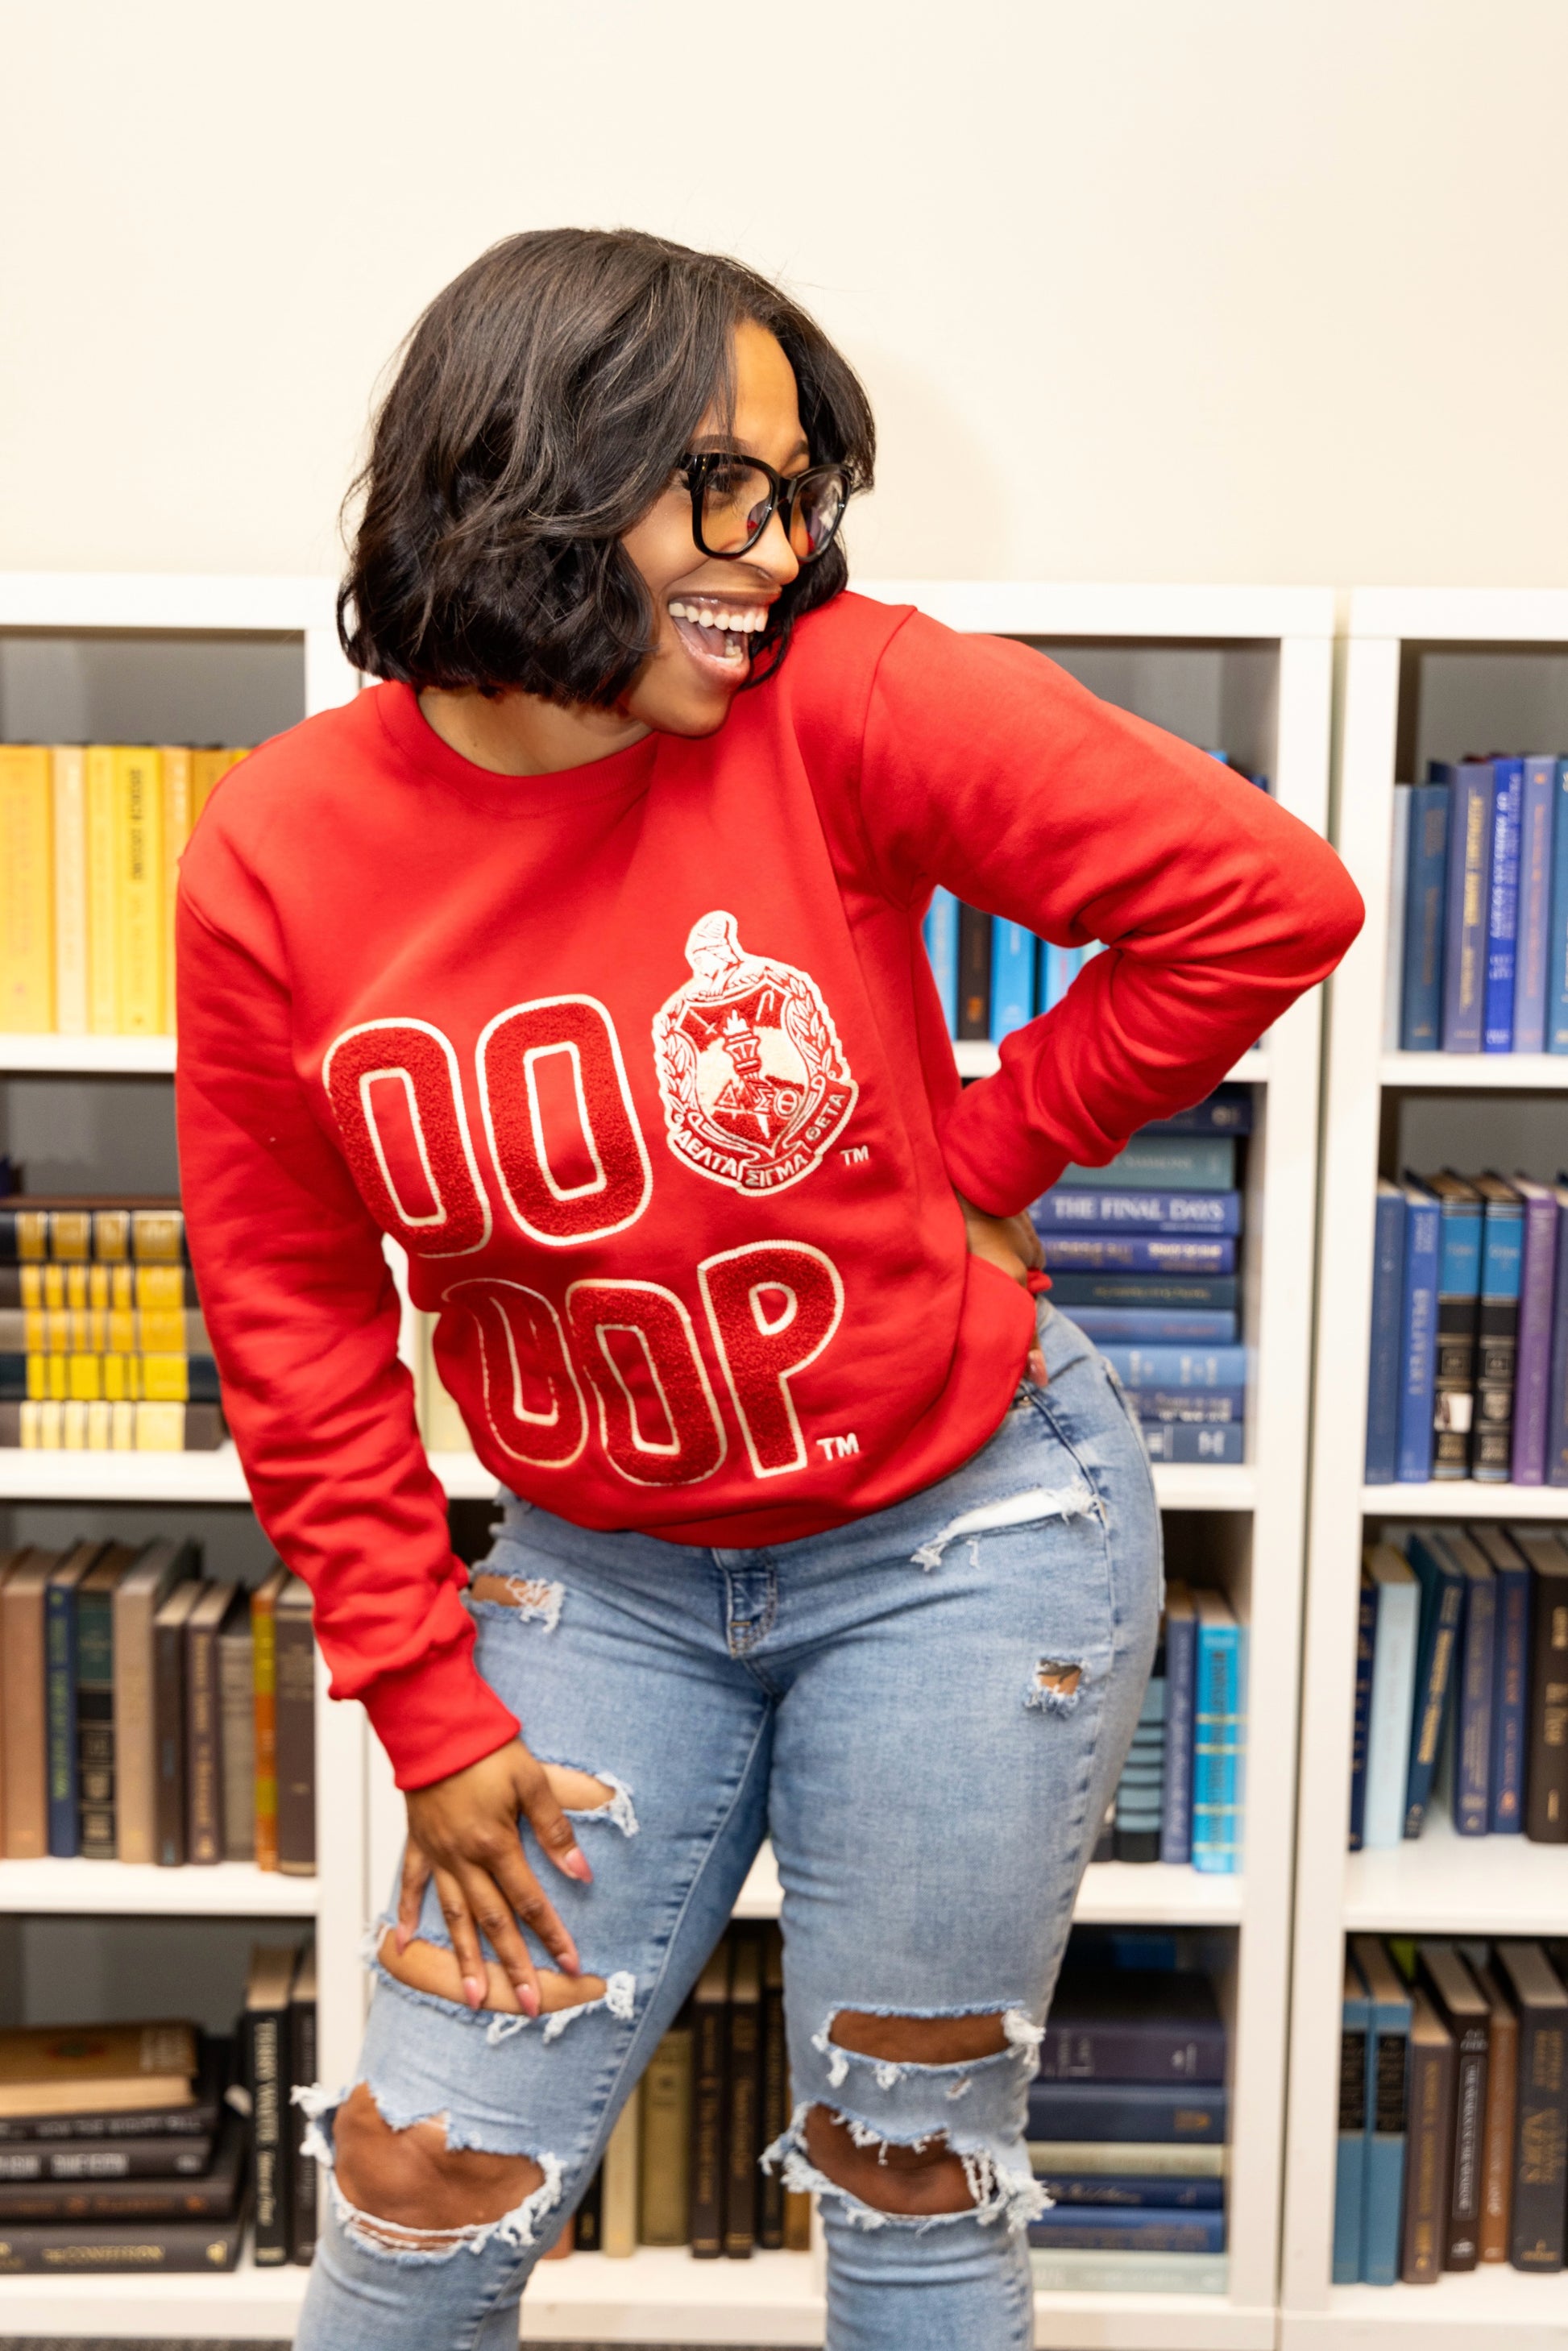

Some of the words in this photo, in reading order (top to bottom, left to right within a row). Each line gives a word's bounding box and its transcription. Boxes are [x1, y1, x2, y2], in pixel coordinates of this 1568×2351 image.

[840, 1145, 869, 1166] TM
[1052, 1196, 1097, 1221] THE
[1101, 1196, 1165, 1221] FINAL
[1169, 1198, 1225, 1223] DAYS
[815, 1433, 860, 1462] TM
